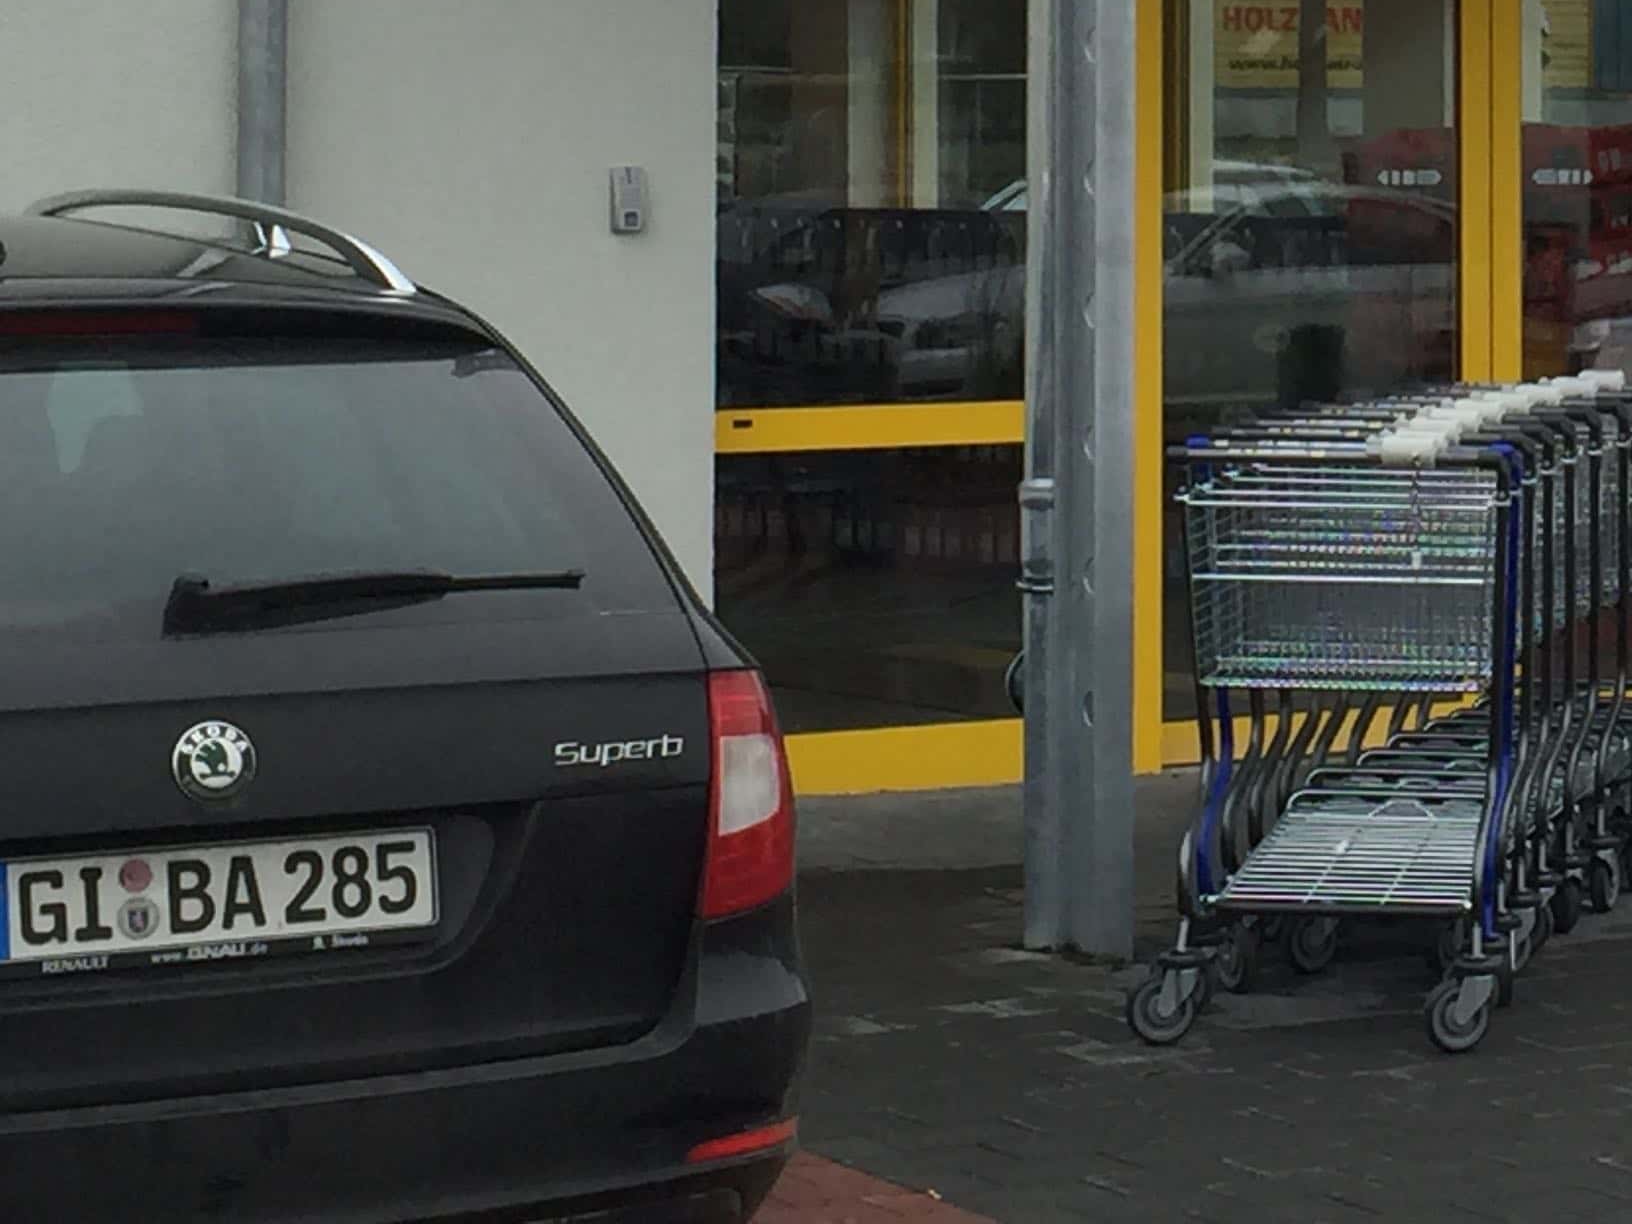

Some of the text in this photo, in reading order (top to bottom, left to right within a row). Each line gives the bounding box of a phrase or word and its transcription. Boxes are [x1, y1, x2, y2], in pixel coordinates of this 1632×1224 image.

[554, 733, 684, 767] Superb
[18, 840, 418, 947] GI BA 285
[41, 956, 109, 974] RENAULT
